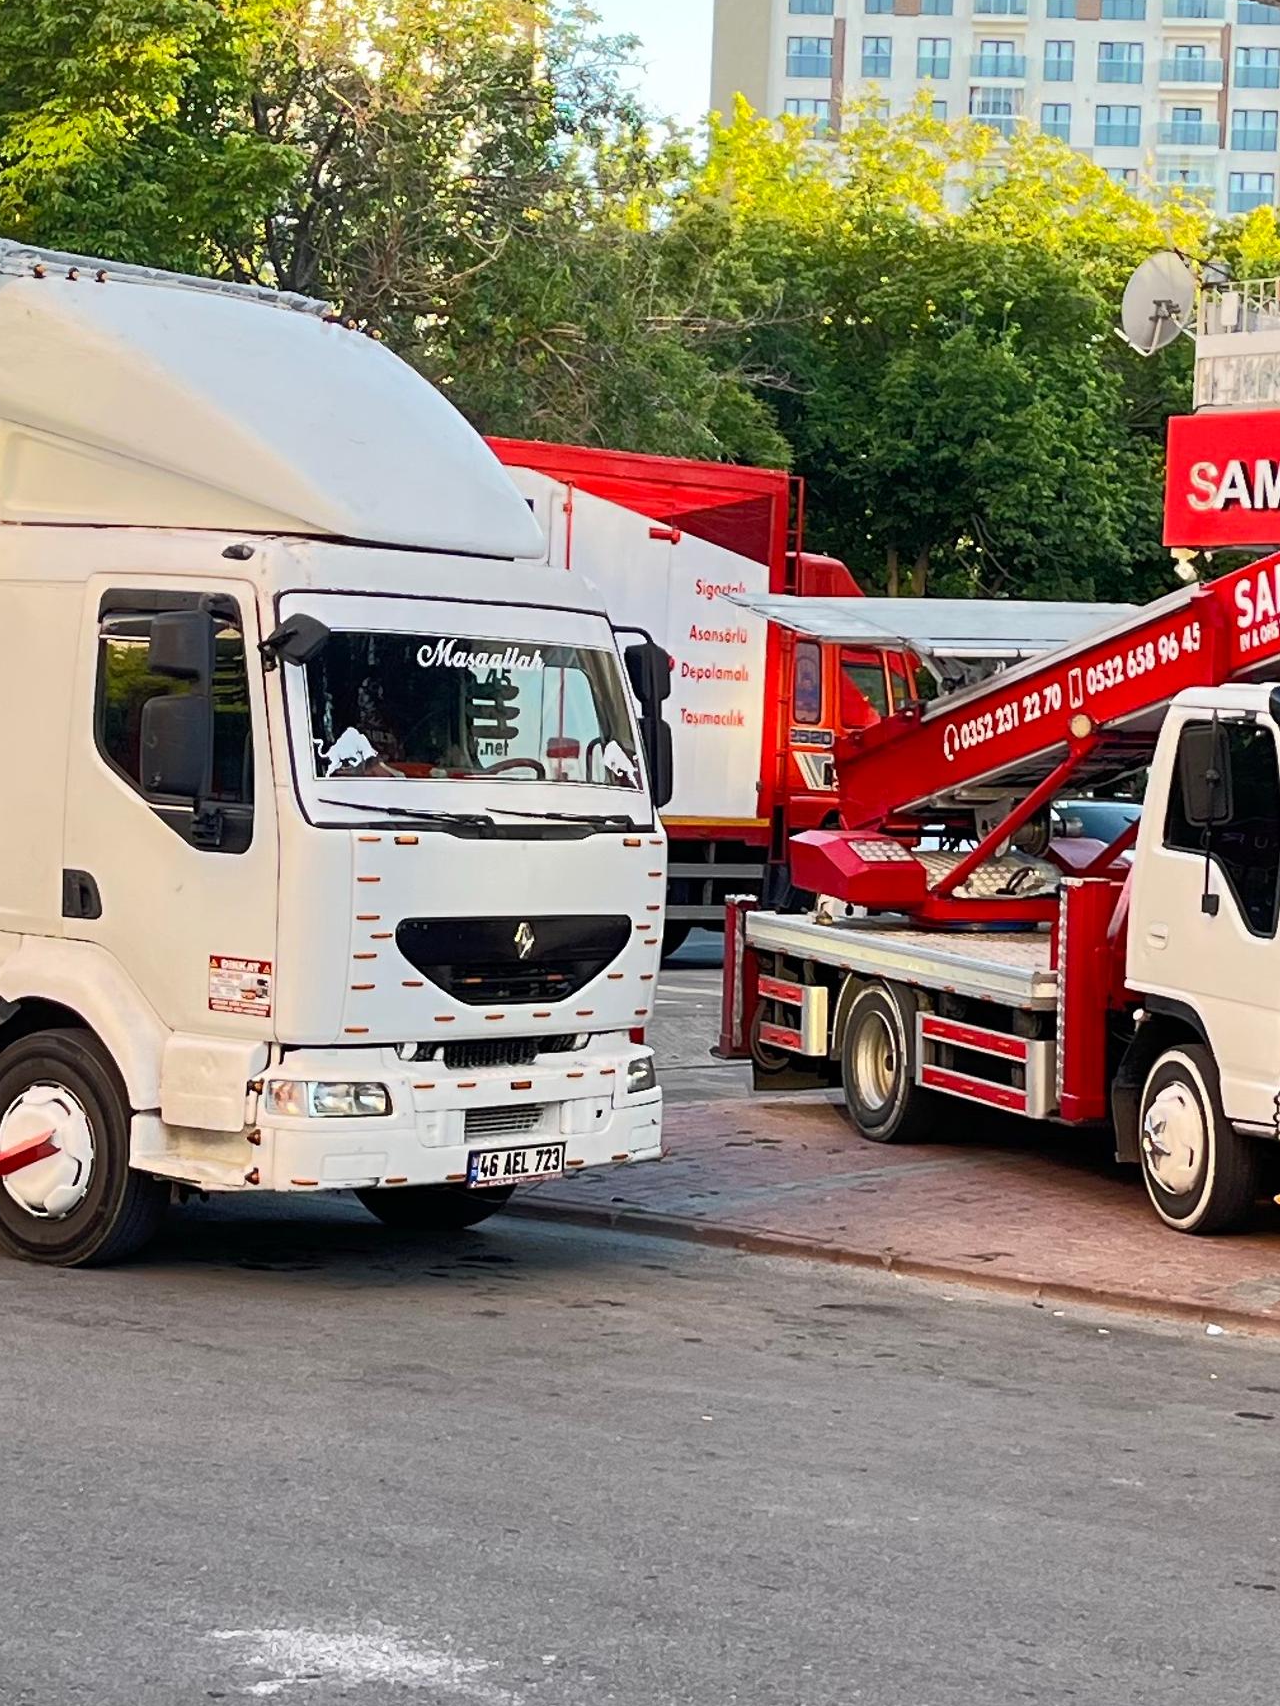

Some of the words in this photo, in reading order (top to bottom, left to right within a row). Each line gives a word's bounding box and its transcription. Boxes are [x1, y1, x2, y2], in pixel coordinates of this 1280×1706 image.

[681, 662, 749, 683] Depolamalı
[960, 714, 994, 748] 0352
[995, 702, 1019, 735] 231
[1022, 692, 1042, 723] 22
[1044, 683, 1062, 714] 70
[1086, 655, 1125, 695] 0532
[1126, 642, 1156, 678] 658
[1158, 632, 1180, 665] 96
[1181, 621, 1201, 654] 45
[681, 709, 745, 727] Taşımacılık
[480, 1154, 499, 1178] 46
[503, 1152, 529, 1176] AEL
[535, 1147, 560, 1173] 723
